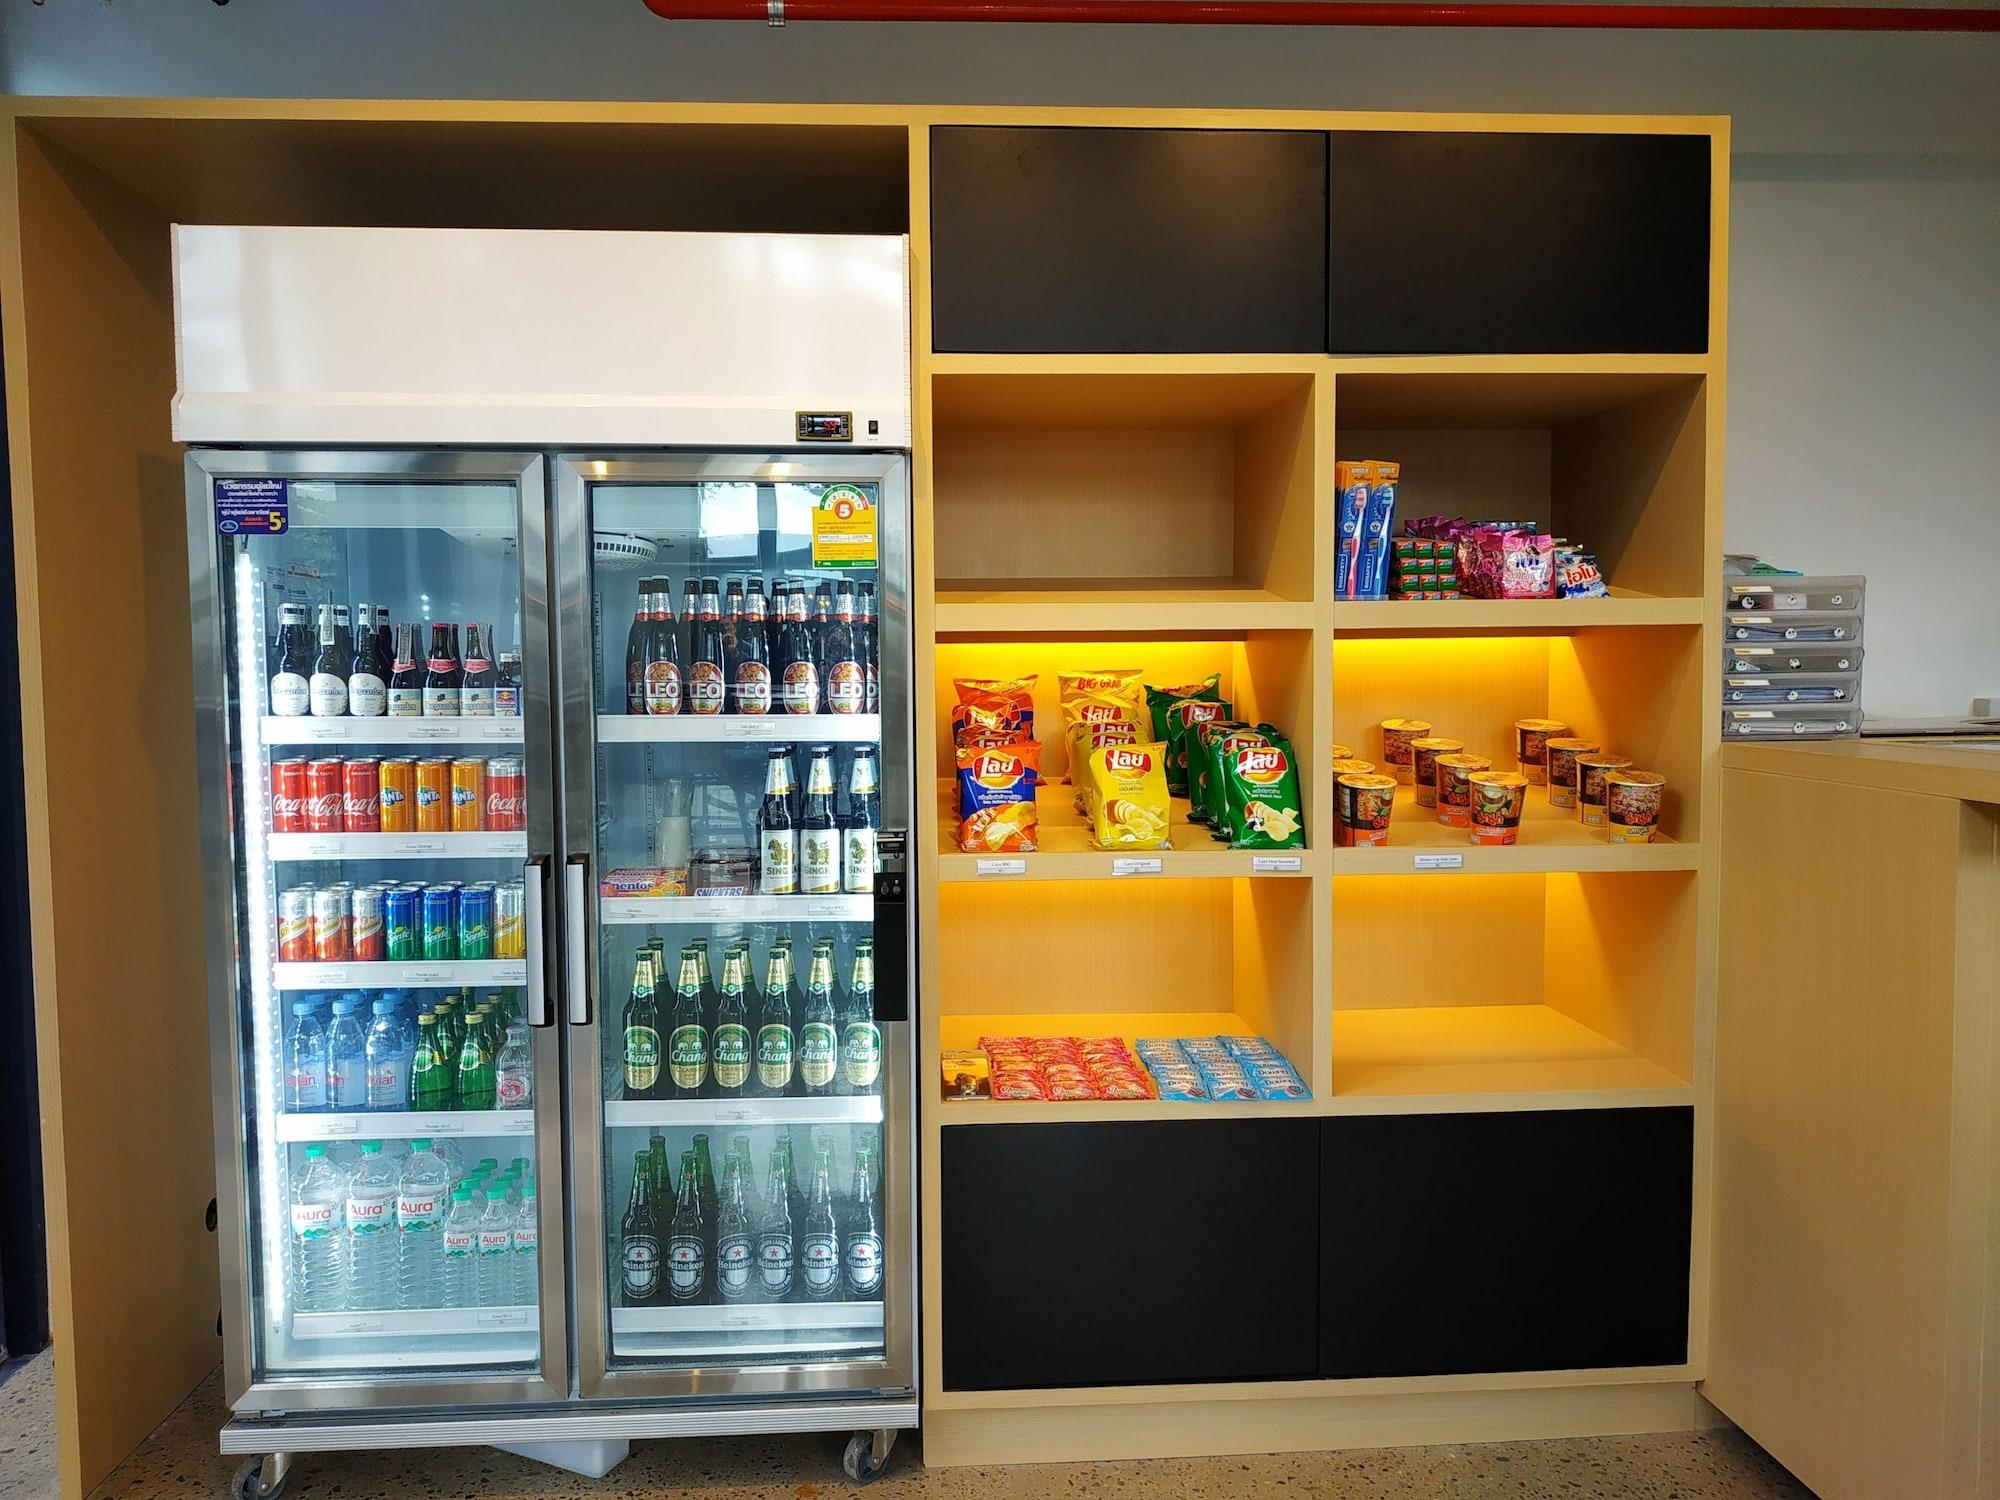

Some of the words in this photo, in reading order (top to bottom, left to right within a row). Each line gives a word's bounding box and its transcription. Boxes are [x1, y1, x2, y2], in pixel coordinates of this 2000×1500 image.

[838, 503, 850, 517] 5
[269, 511, 282, 531] 5
[646, 682, 679, 698] LEO
[689, 682, 721, 698] LEO
[737, 682, 770, 698] LEO
[785, 682, 819, 698] LEO
[830, 682, 863, 698] LEO
[1078, 678, 1097, 690] BIG
[1100, 679, 1121, 689] GRAB
[388, 930, 410, 944] Sprite
[427, 930, 449, 944] Sprite
[465, 929, 488, 943] Sprite
[624, 1049, 657, 1064] Chang
[672, 1049, 707, 1062] Chang
[714, 1048, 748, 1062] Chang
[758, 1048, 792, 1063] Chang
[800, 1046, 833, 1061] Chang
[844, 1046, 879, 1061] Chang
[351, 1203, 383, 1216] Aura
[400, 1201, 433, 1213] Aura
[297, 1208, 332, 1221] Aura
[446, 1236, 469, 1245] Aura
[482, 1235, 506, 1244] Aura
[622, 1260, 659, 1271] Heineken
[667, 1260, 704, 1271] Heineken
[717, 1258, 753, 1270] Heineken
[757, 1258, 794, 1269] Heineken
[801, 1257, 838, 1269] Heineken
[846, 1256, 881, 1268] Heineken
